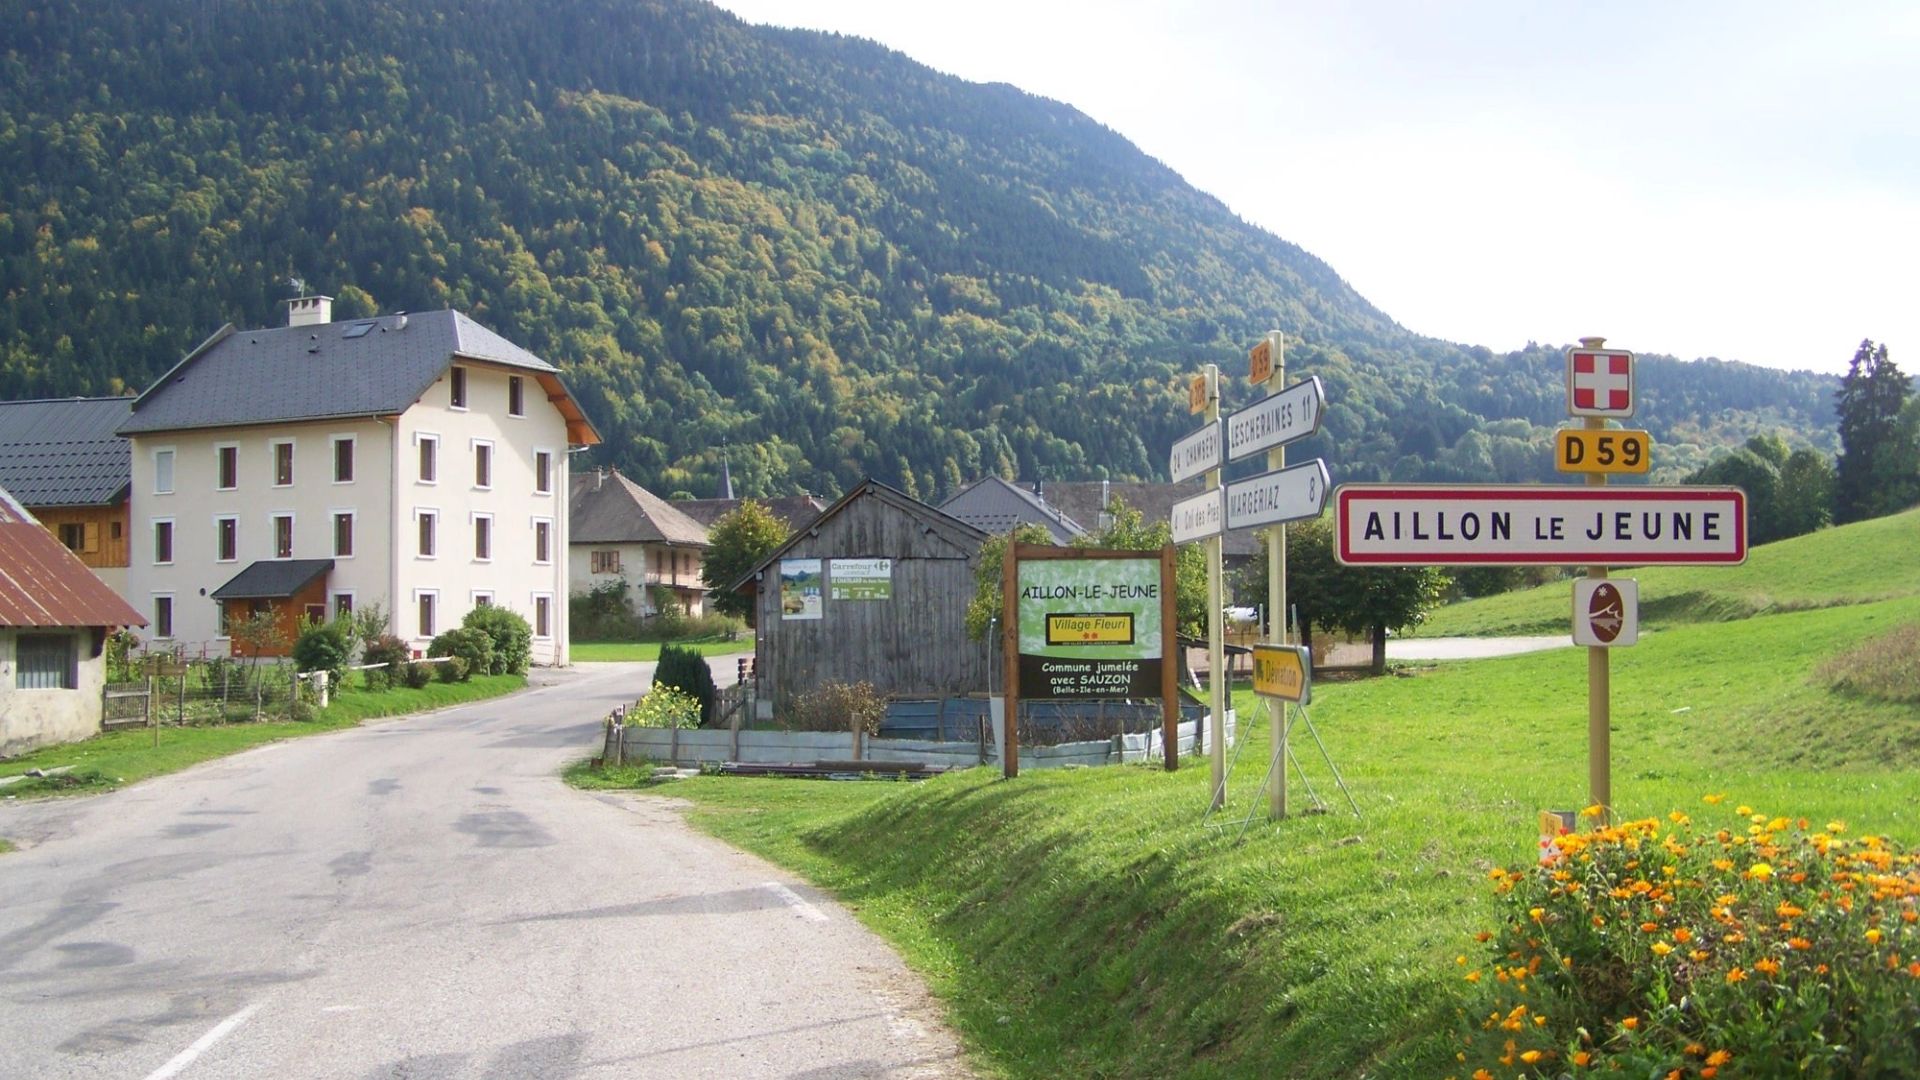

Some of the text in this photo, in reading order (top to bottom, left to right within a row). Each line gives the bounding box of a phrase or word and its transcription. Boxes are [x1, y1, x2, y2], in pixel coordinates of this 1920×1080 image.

[1231, 395, 1311, 449] LESCHERAINES 11
[1565, 436, 1642, 467] D 59
[1230, 477, 1315, 518] MARGÉRIAZ 8
[1364, 512, 1720, 541] AILLON LE JEUNE
[1022, 585, 1157, 599] AILLON-LE-JEUNE
[1054, 618, 1126, 631] Village Fleuri
[1042, 661, 1139, 674] Commune jumelée
[1080, 675, 1130, 684] SAUZON
